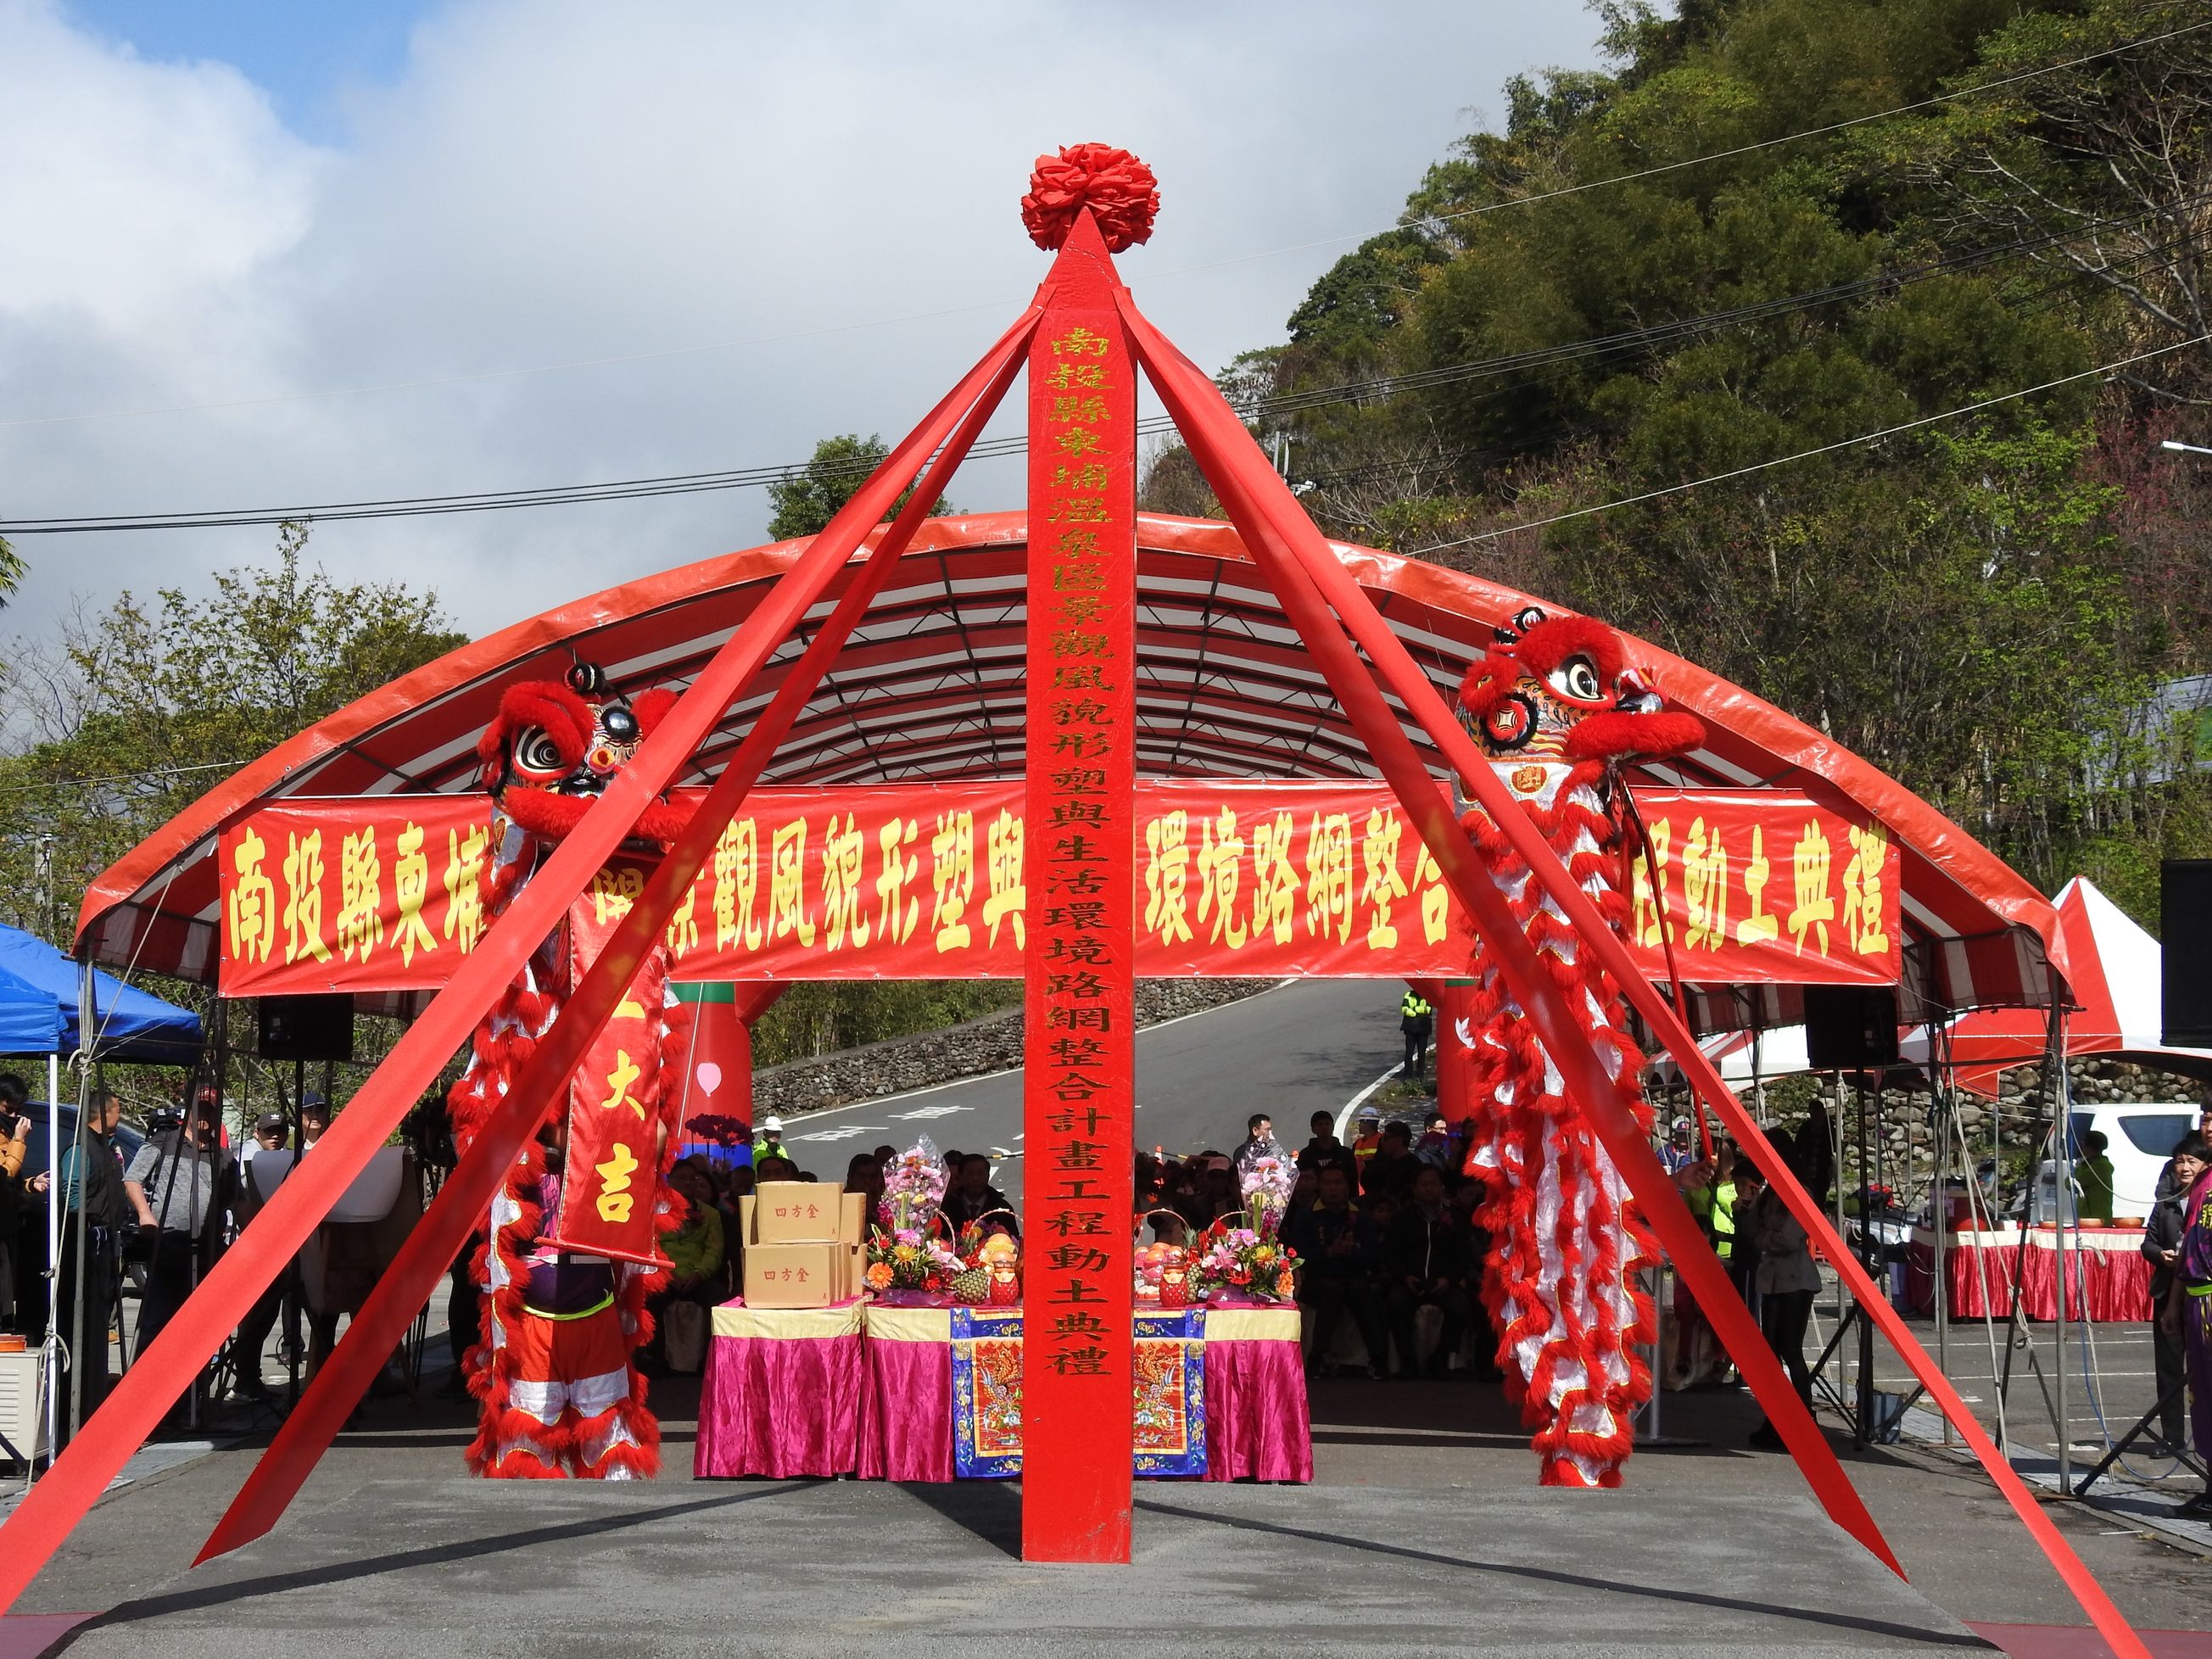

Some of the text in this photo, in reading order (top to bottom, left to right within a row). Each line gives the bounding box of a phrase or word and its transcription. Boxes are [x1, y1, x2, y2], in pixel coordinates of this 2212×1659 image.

[775, 1204, 819, 1219] 四方金
[763, 1267, 810, 1282] 四方金
